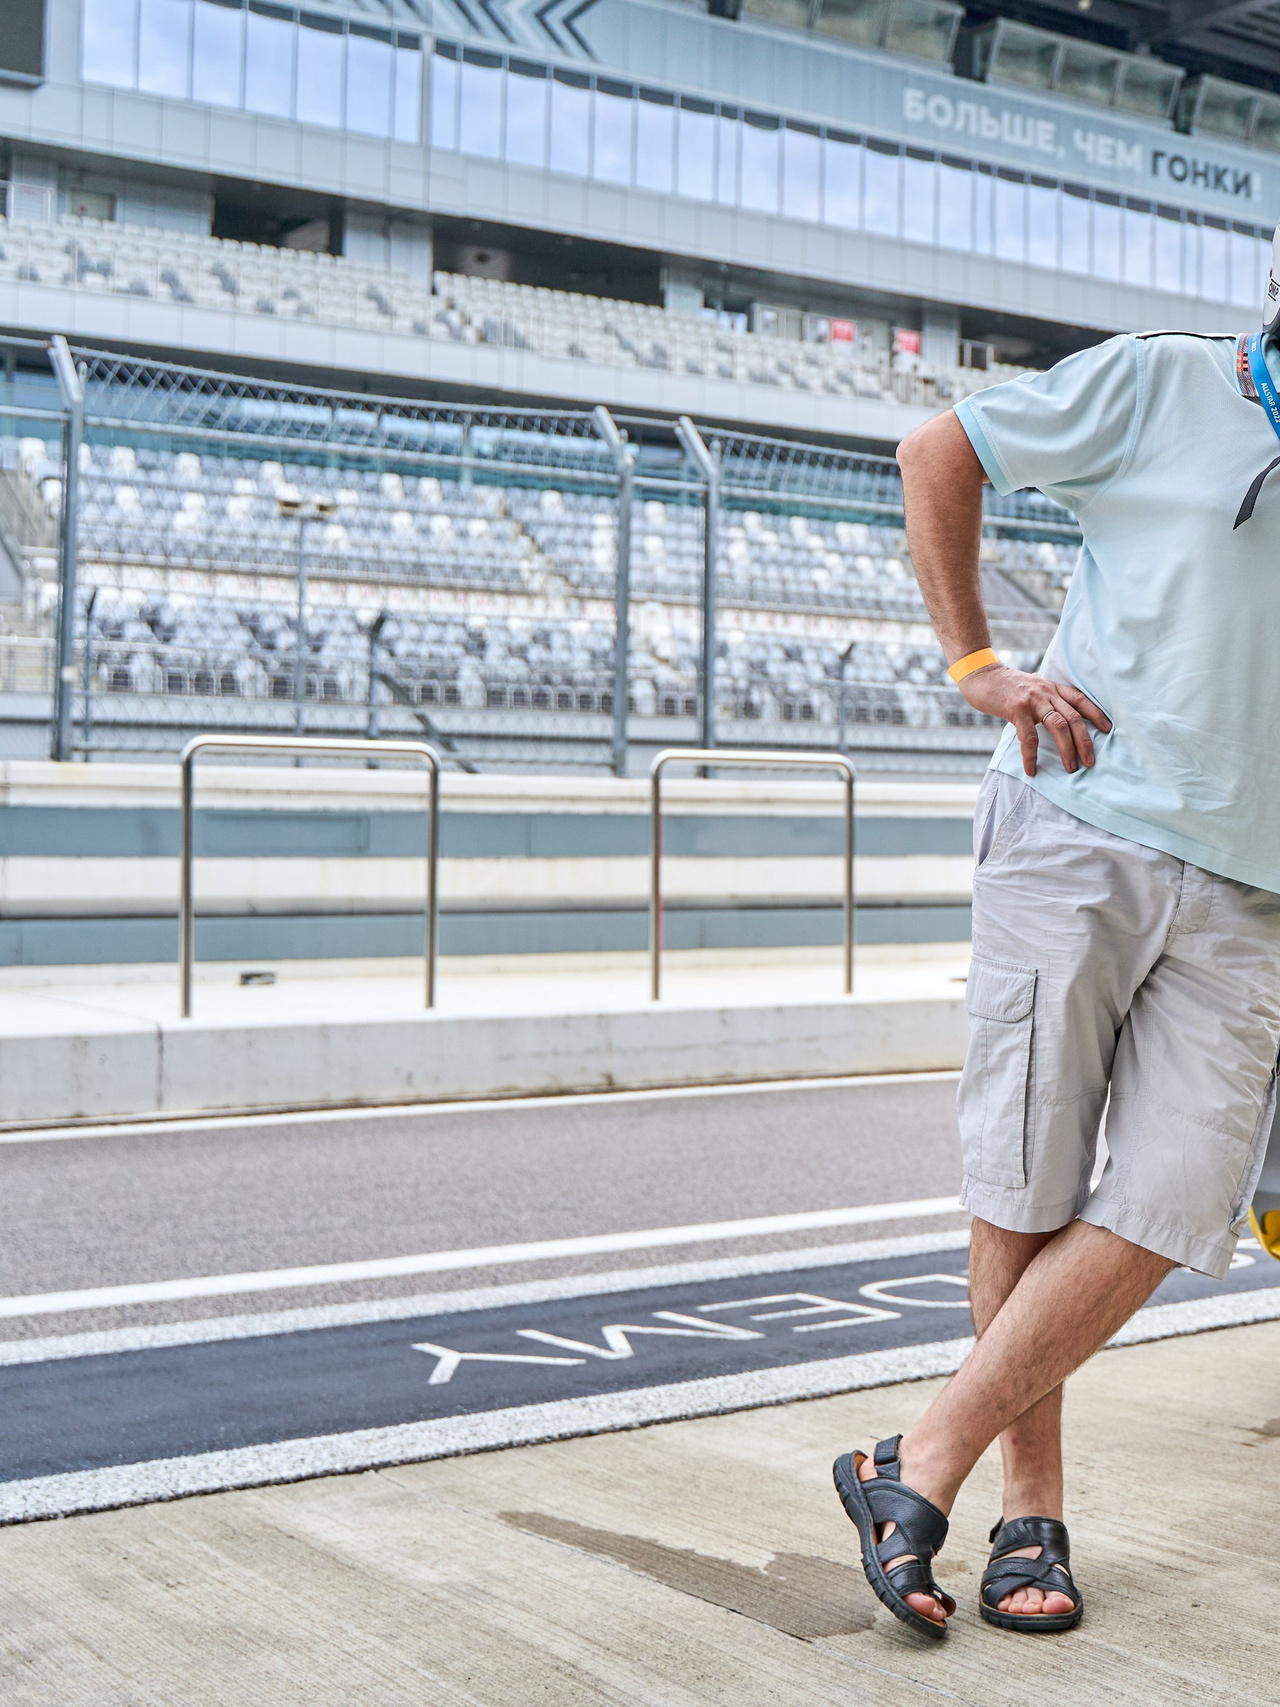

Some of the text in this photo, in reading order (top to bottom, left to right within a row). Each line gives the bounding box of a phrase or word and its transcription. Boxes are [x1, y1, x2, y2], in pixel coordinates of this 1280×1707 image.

[903, 87, 1252, 199] БОЛЬШЕ, ЧЕМ ГОНКИ
[1261, 382, 1276, 407] ALLSTAR
